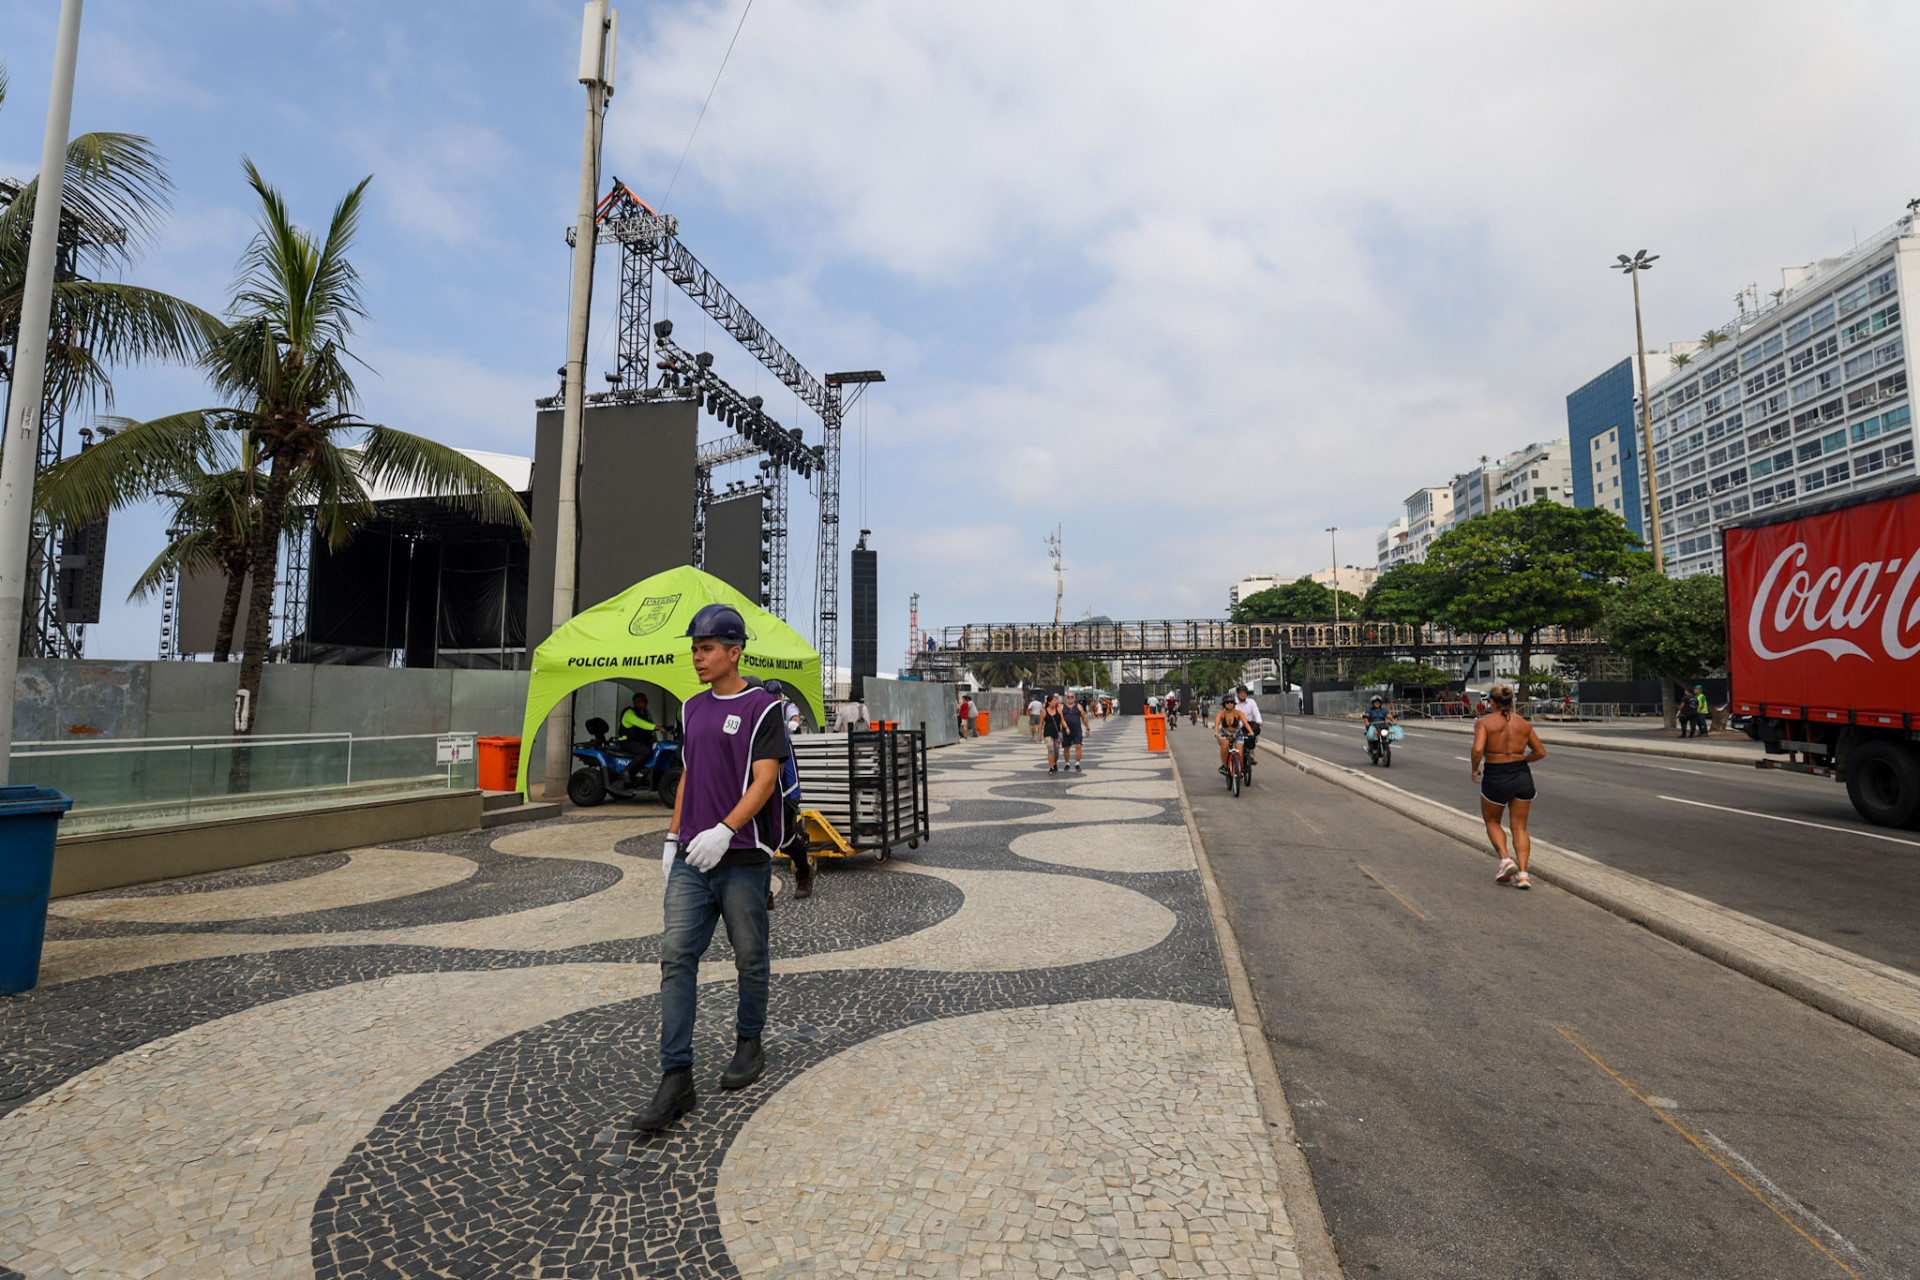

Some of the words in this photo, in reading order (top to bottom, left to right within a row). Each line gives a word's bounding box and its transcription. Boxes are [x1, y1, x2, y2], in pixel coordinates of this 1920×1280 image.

[1748, 541, 1920, 662] Coca-C
[622, 653, 675, 666] MILITAR
[776, 658, 803, 670] MILITAR
[725, 719, 739, 730] 513
